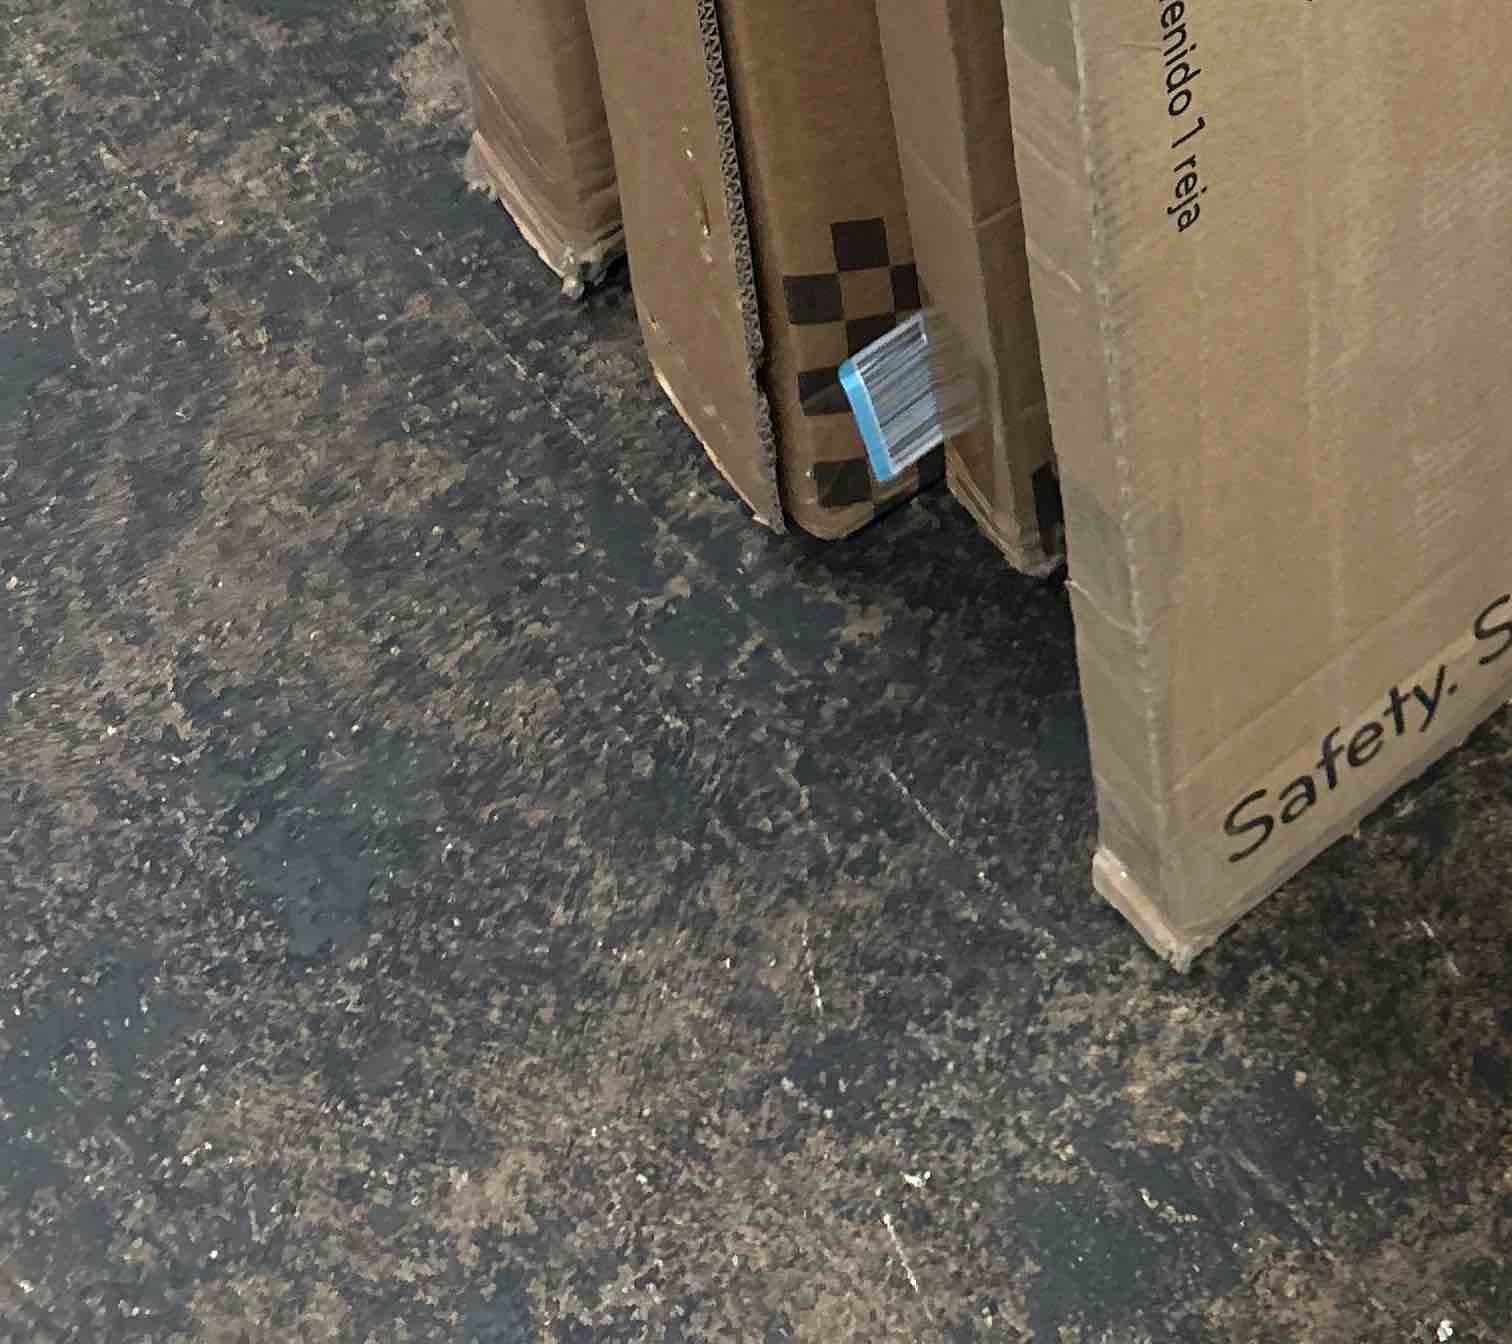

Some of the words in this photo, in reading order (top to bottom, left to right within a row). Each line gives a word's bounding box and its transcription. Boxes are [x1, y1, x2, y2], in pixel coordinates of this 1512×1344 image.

[1171, 116, 1207, 150] 1
[1167, 153, 1208, 234] reja
[1222, 664, 1460, 864] Safety.
